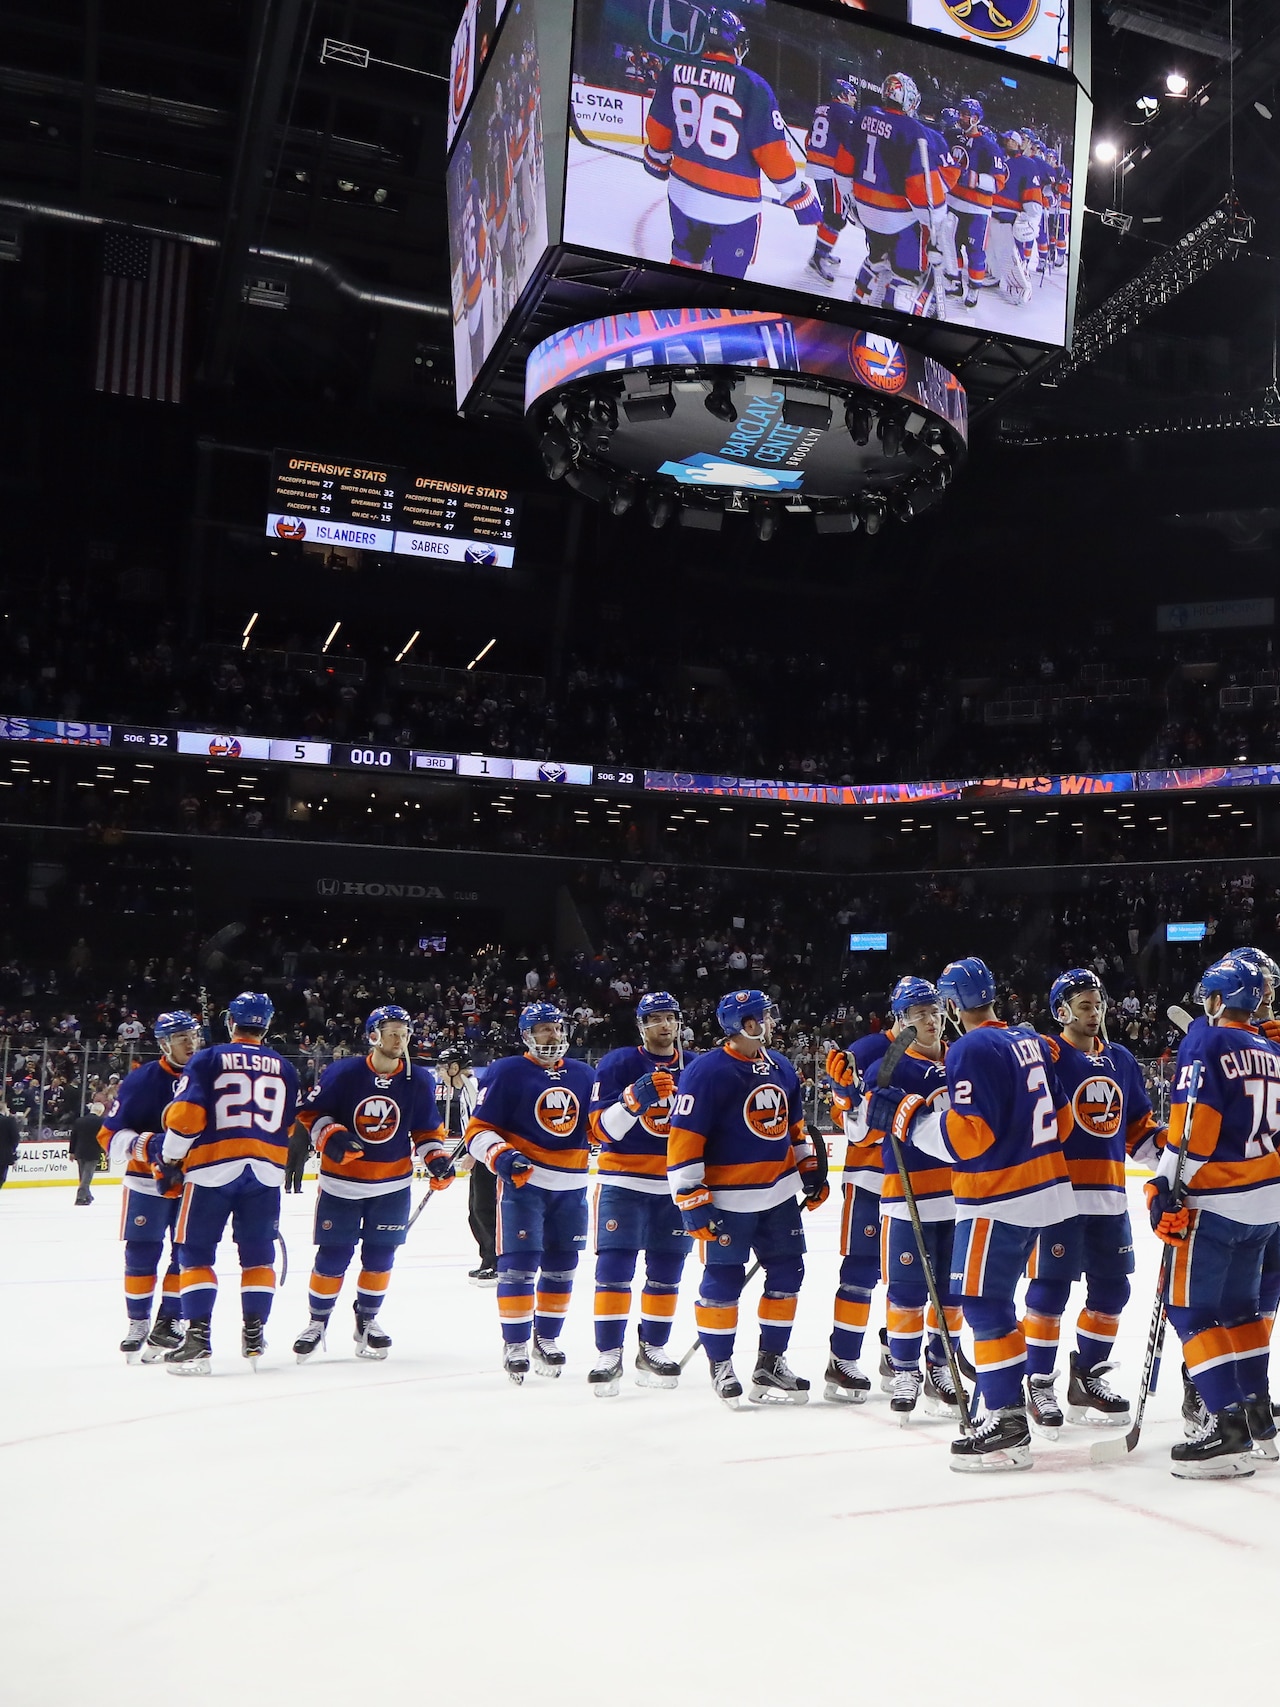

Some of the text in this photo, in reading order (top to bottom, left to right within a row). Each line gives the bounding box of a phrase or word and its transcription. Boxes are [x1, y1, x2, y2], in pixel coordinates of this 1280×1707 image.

[673, 64, 736, 95] KULEMIN
[587, 95, 623, 111] STAR
[672, 87, 742, 160] 86
[861, 116, 892, 139] GREISS
[862, 134, 877, 183] 1
[939, 152, 954, 167] 14
[994, 156, 1003, 168] 16
[571, 311, 641, 360] WIN
[289, 459, 387, 483] OFFENSIVE STATS
[278, 475, 306, 485] FACEOFFS
[323, 480, 334, 488] 27
[415, 478, 508, 500] OFFENSIVE STATS
[277, 488, 304, 497] FACEOFFS
[321, 493, 332, 501] 24
[383, 490, 394, 498] 32
[405, 494, 431, 502] FACEOFFS
[447, 499, 457, 507] 24
[287, 502, 311, 511] FACEOFF
[320, 506, 331, 514] 52
[382, 502, 393, 510] 15
[403, 506, 429, 514] FACEOFFS
[445, 511, 456, 519] 27
[504, 507, 515, 515] 29
[381, 514, 391, 522] 15
[413, 520, 435, 528] FACEOFF
[505, 519, 511, 527] 6
[316, 526, 377, 545] ISLANDERS
[411, 539, 450, 555] SABRES
[123, 734, 168, 747] SOG: 32
[294, 745, 306, 759] 5
[351, 749, 392, 766] 00.0
[426, 758, 446, 768] 3RD
[480, 760, 490, 774] 1
[597, 772, 634, 783] SOG: 29
[342, 882, 446, 898] HONDA
[221, 1053, 281, 1075] NELSON
[955, 1080, 972, 1105] 2
[1086, 1081, 1116, 1107] NY
[214, 1072, 286, 1134] 29
[546, 1091, 572, 1114] NY
[755, 1089, 781, 1113] NY
[1027, 1066, 1059, 1148] 2
[364, 1099, 393, 1121] NY
[22, 1149, 68, 1160] ALL STAR
[12, 1164, 68, 1173] NHL.com/Vote
